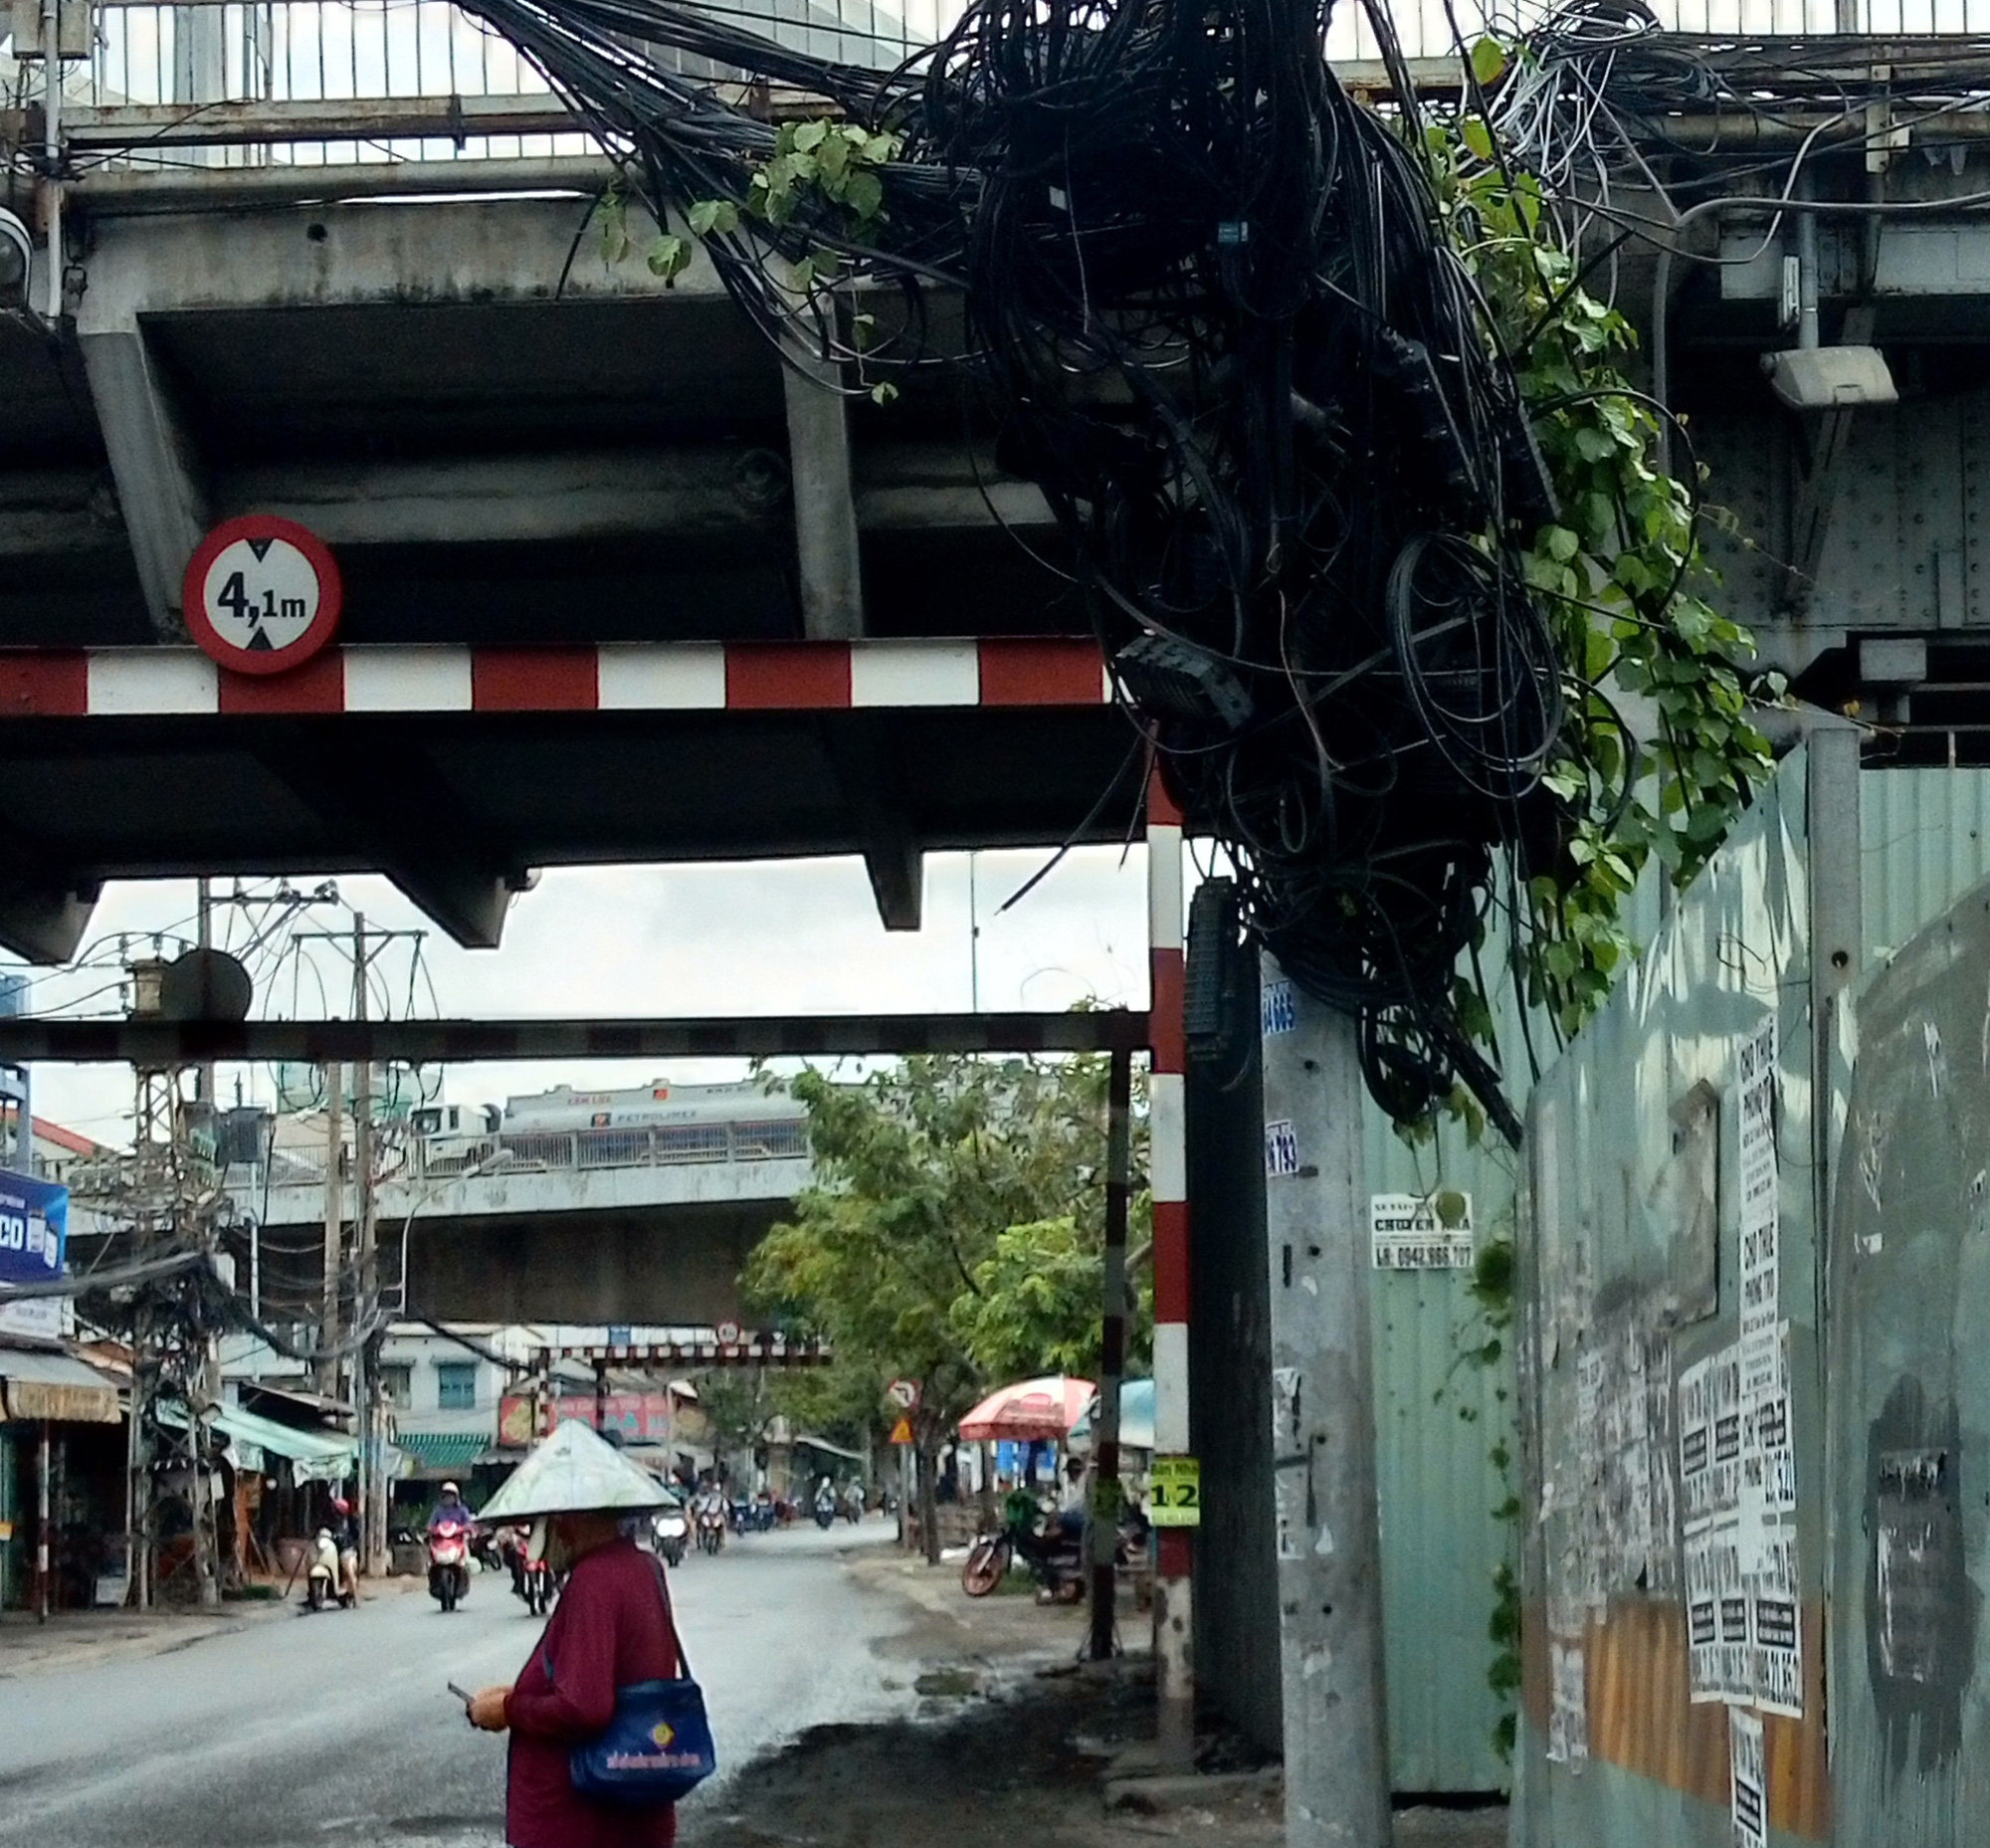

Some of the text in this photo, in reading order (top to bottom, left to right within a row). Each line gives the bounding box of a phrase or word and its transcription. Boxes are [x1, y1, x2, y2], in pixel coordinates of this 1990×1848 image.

[217, 571, 305, 628] 4,1m
[618, 1110, 696, 1123] PETROLIMEX
[1151, 1484, 1198, 1508] 12
